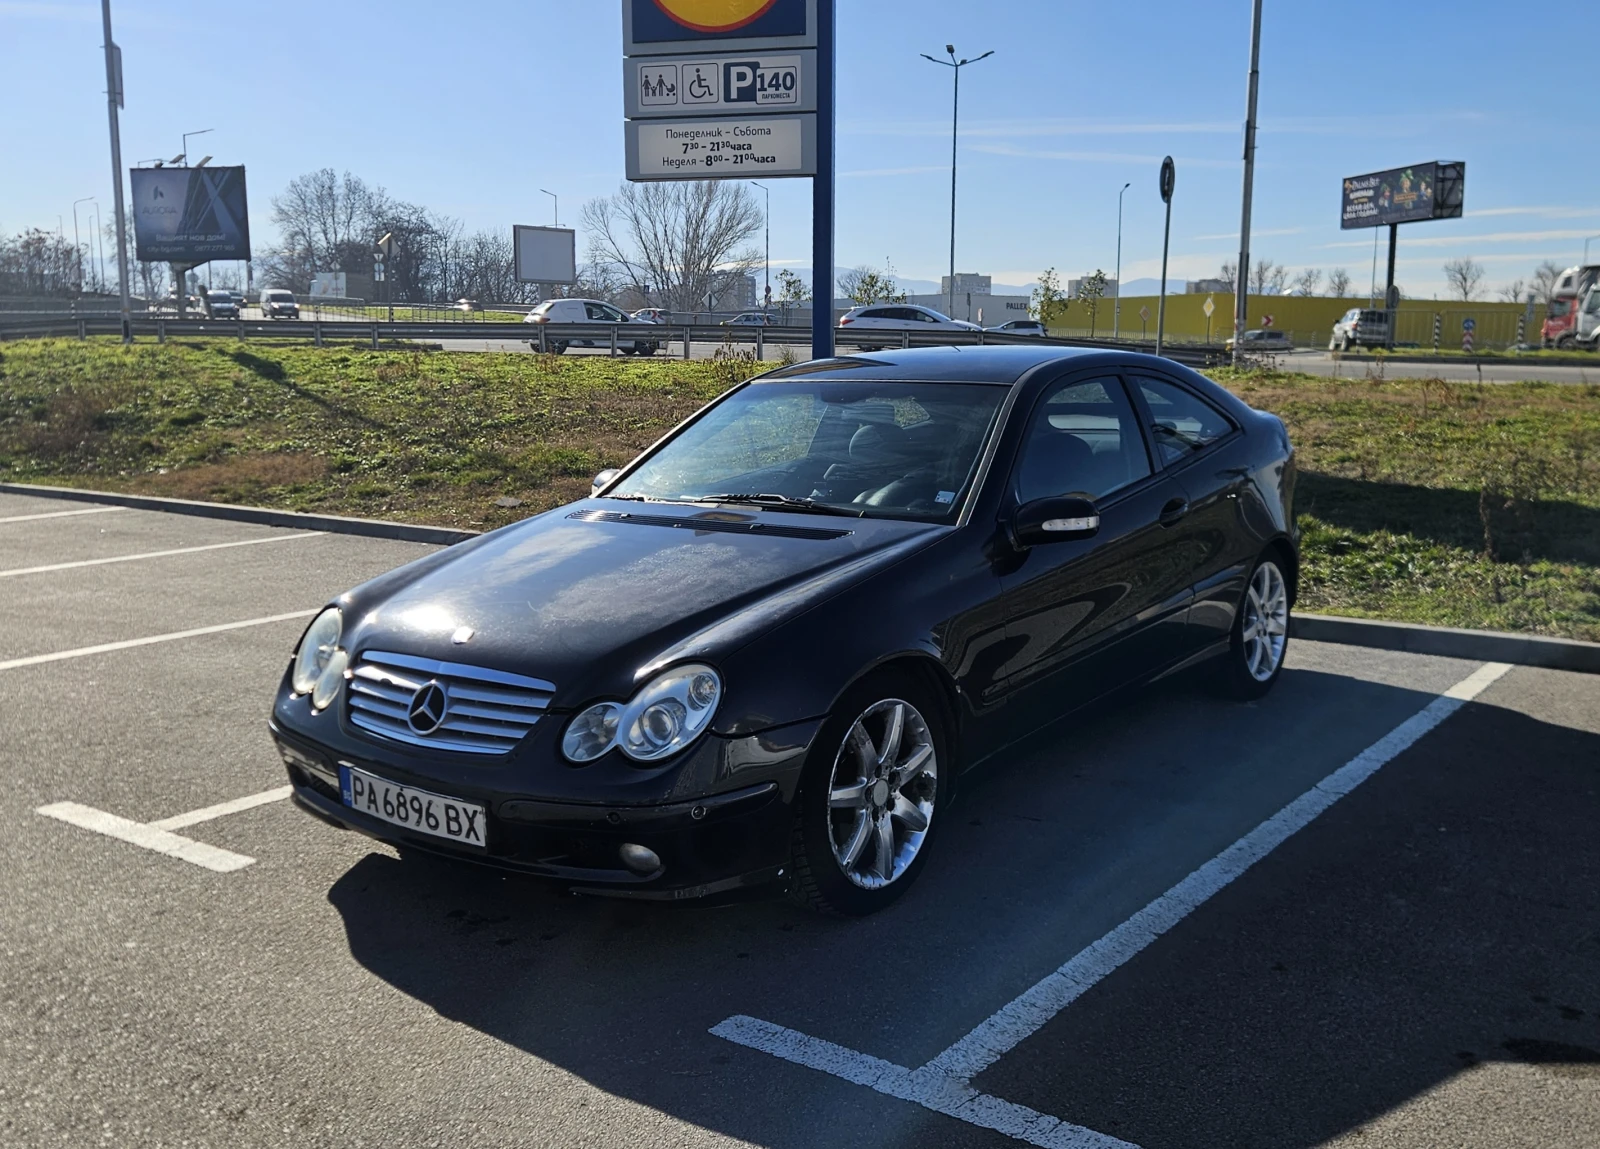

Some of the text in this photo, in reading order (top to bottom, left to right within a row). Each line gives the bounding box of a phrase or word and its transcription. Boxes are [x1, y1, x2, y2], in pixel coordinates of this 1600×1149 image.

[730, 66, 753, 99] P
[757, 71, 795, 92] 140
[761, 92, 791, 100] ПАРКОМЕСТА
[665, 128, 723, 141] Понеделник
[733, 126, 772, 137] Събота
[662, 157, 697, 169] Неделя
[1006, 302, 1028, 310] PALLEX
